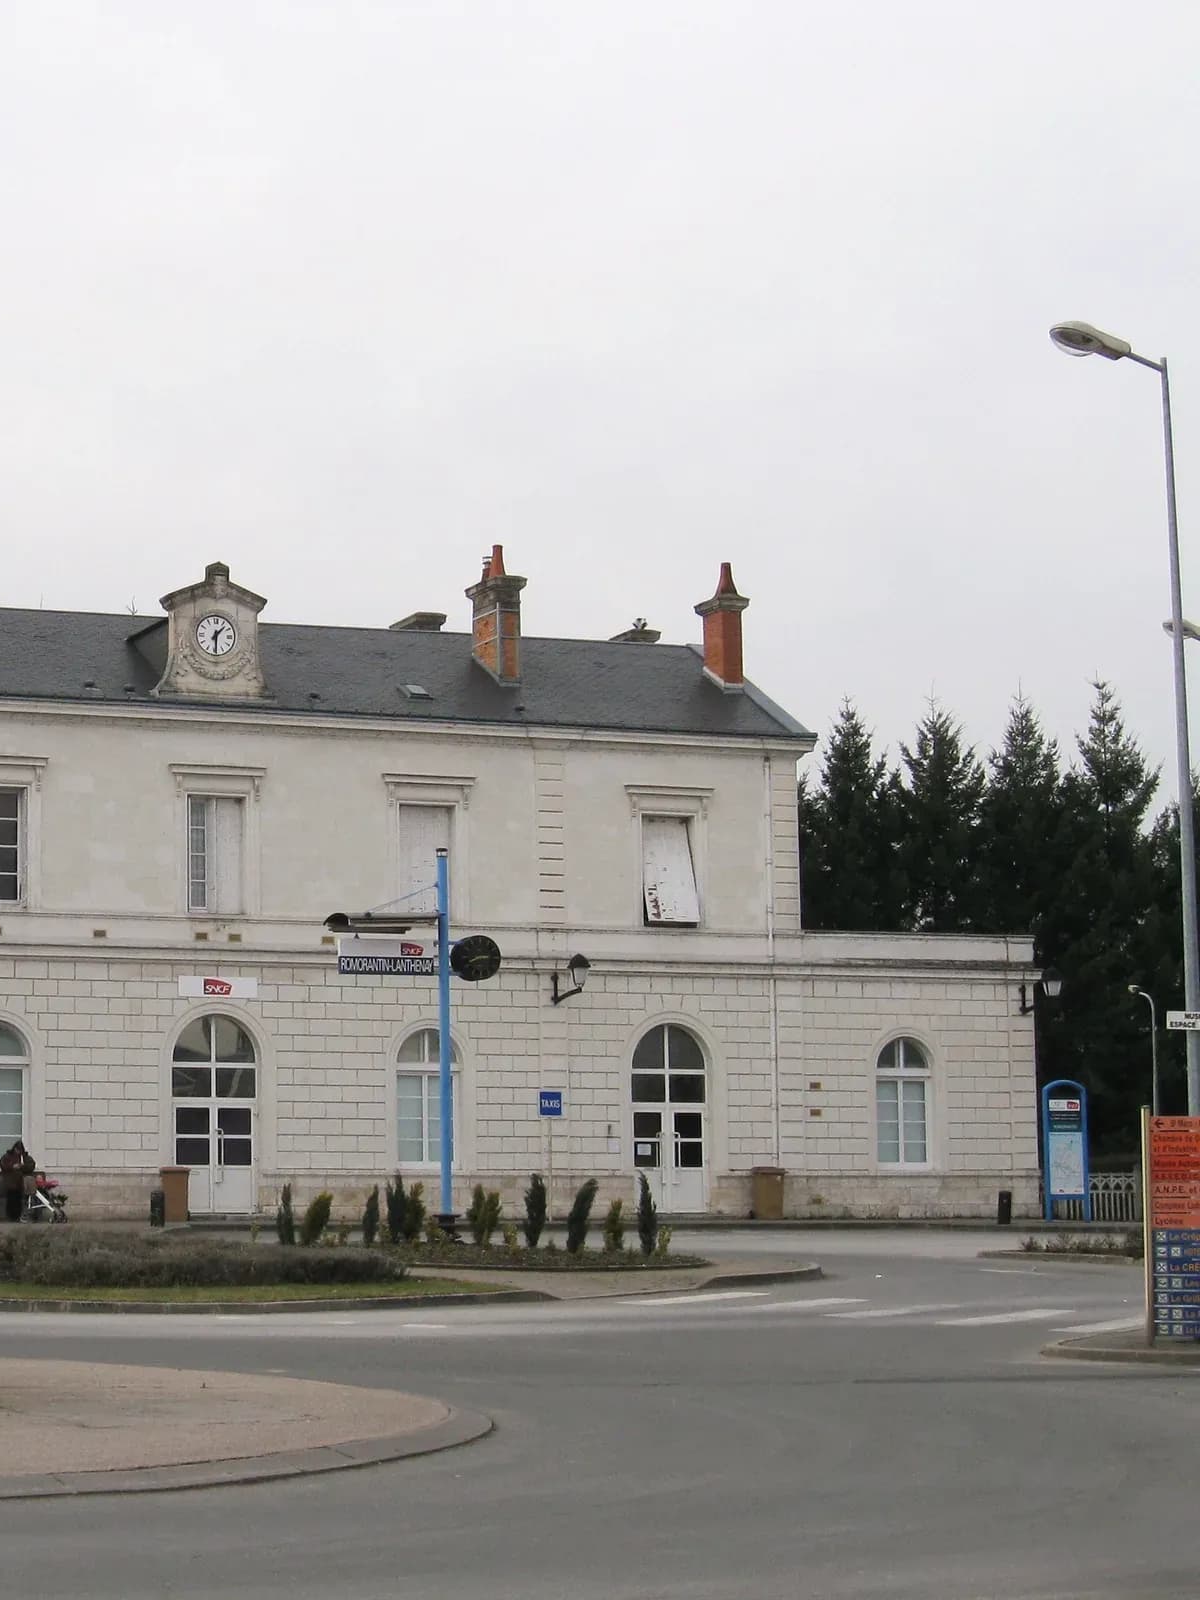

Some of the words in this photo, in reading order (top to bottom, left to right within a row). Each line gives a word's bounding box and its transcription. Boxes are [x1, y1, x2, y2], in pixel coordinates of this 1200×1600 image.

[340, 957, 433, 973] ROMORANTIN-LANTHENAY
[204, 984, 231, 994] SNCF
[541, 1099, 560, 1108] TAXIS
[1155, 1185, 1186, 1194] A.N.P.E.
